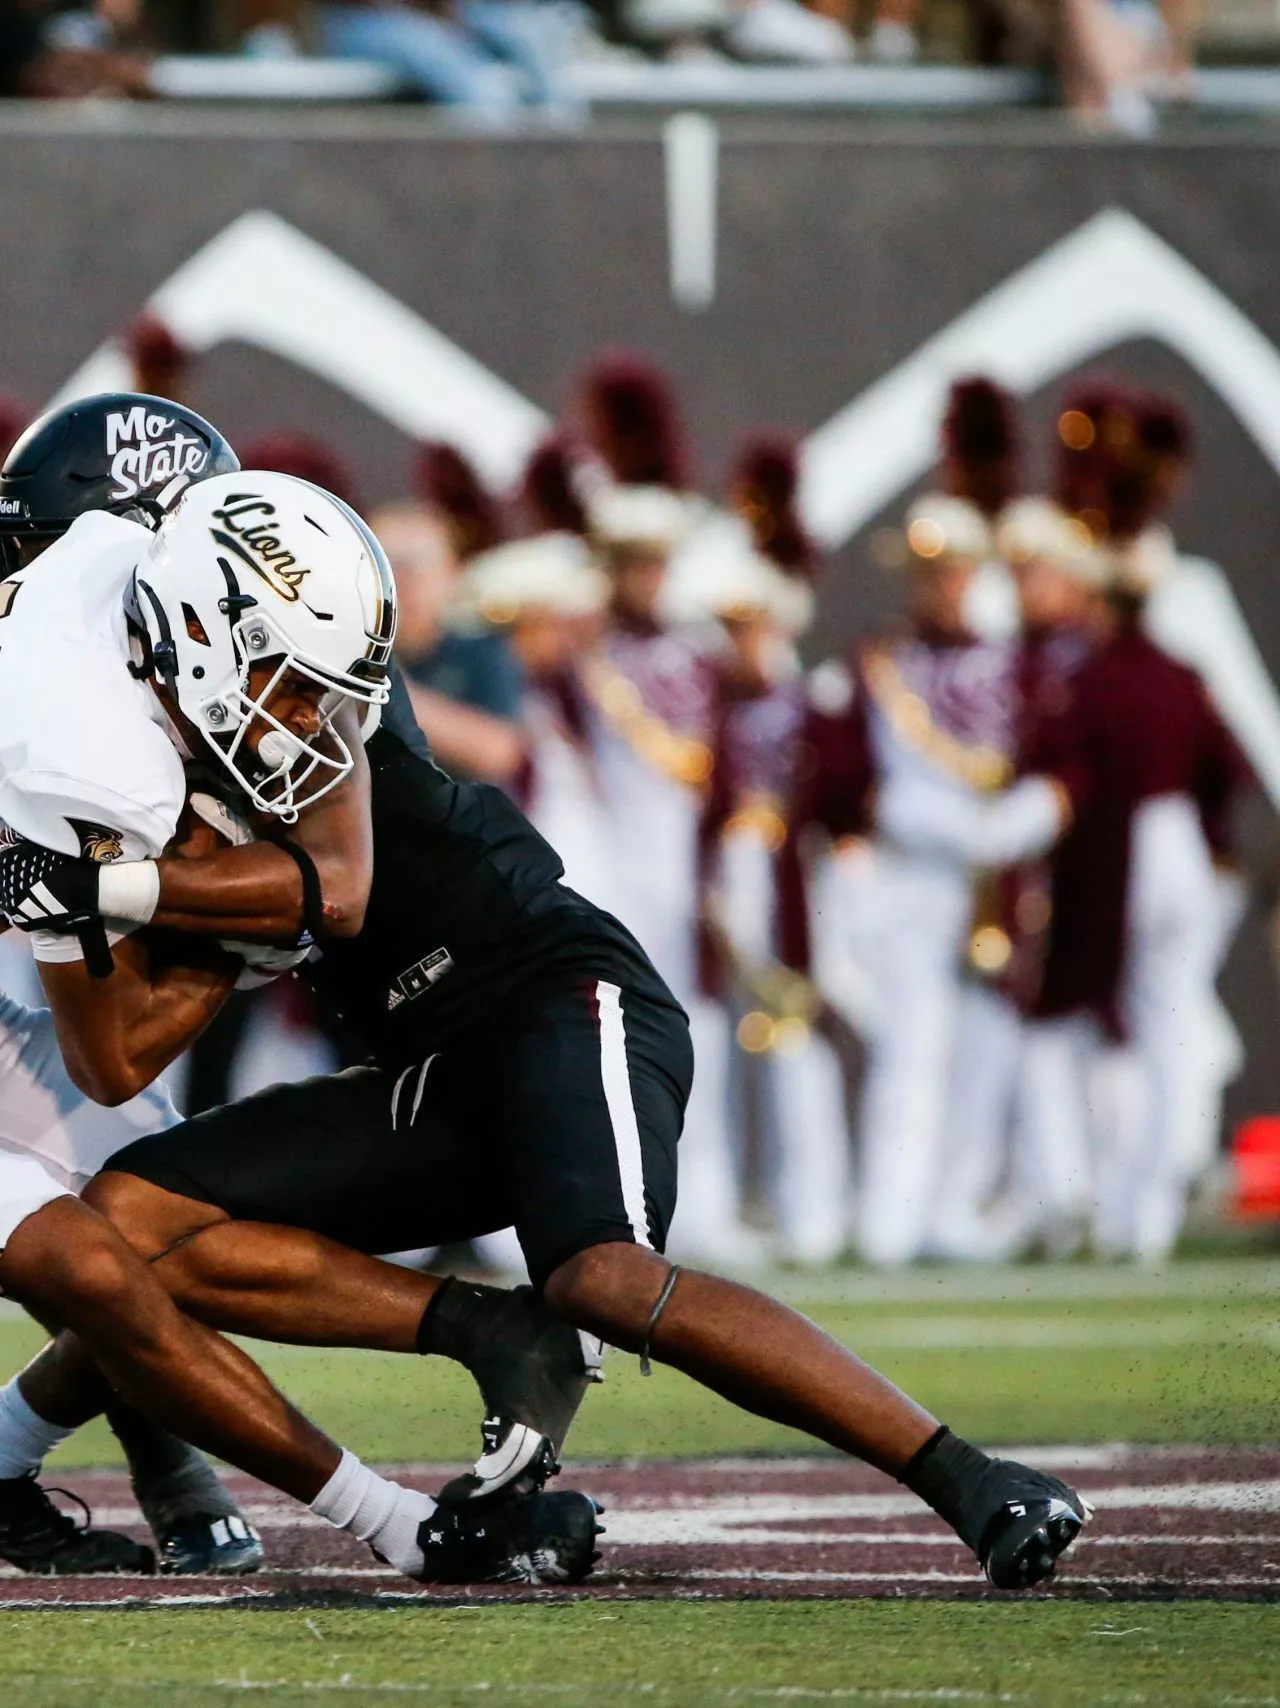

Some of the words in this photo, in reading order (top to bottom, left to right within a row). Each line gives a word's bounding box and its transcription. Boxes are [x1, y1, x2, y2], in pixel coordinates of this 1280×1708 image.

[106, 406, 176, 456] Mo
[111, 433, 208, 500] State
[211, 501, 311, 594] Lions
